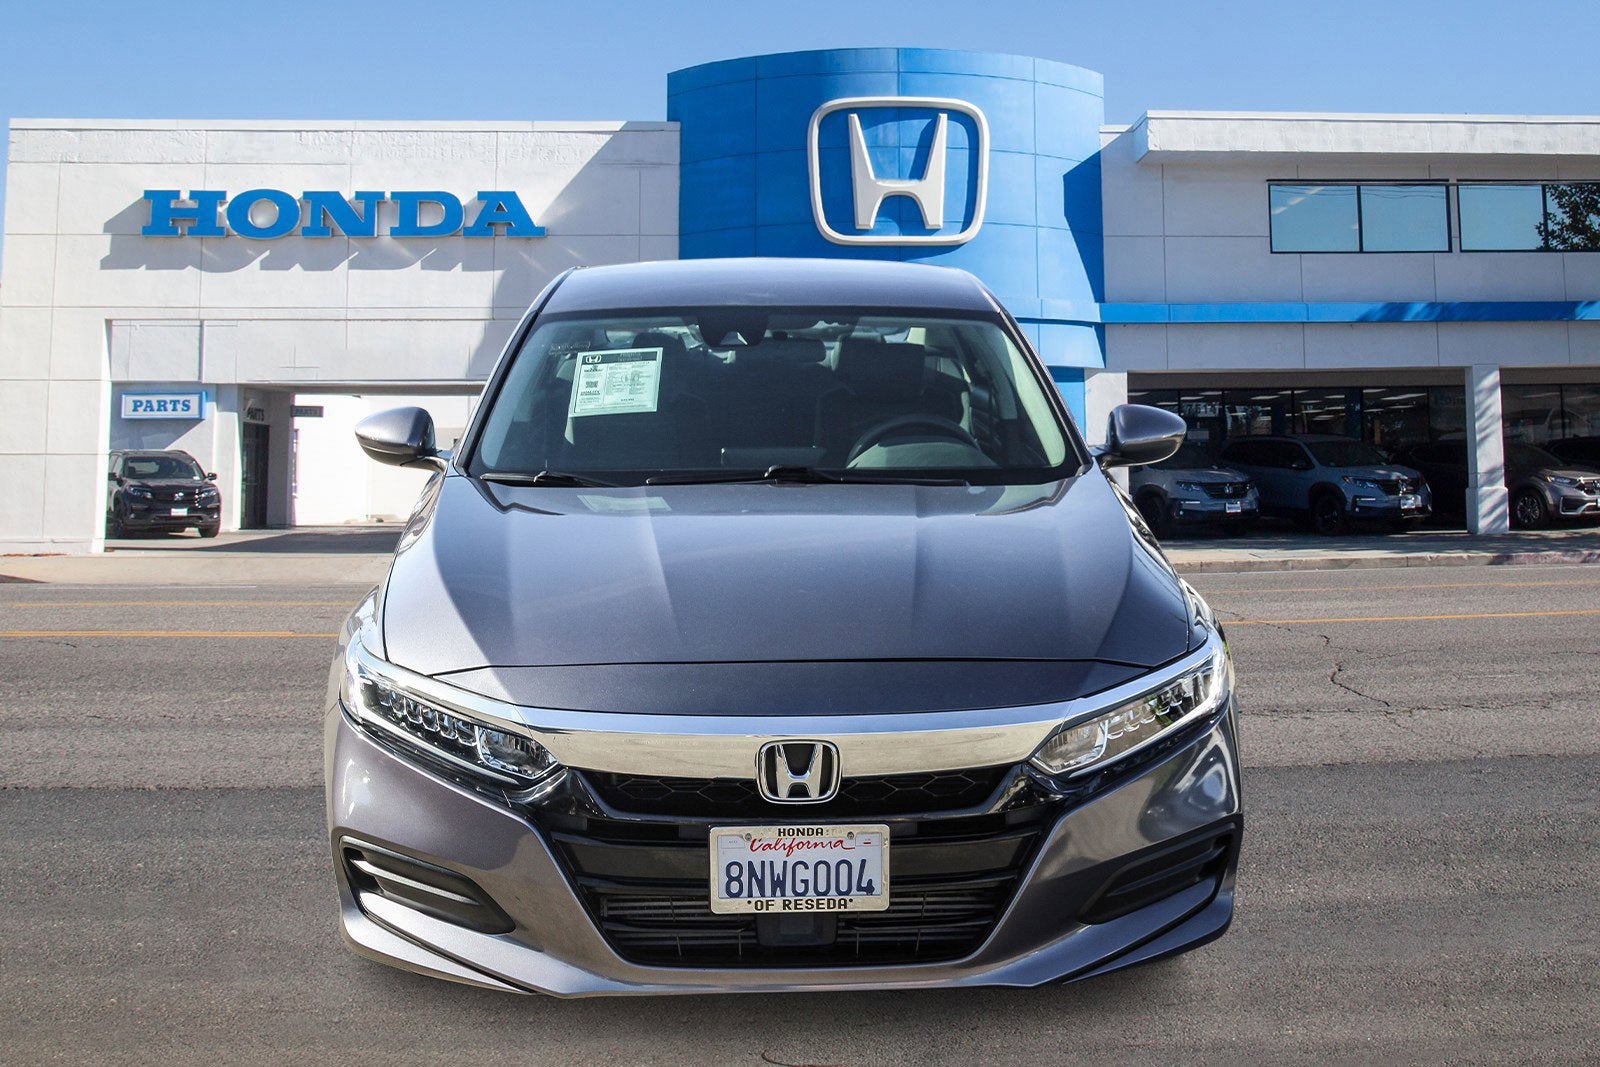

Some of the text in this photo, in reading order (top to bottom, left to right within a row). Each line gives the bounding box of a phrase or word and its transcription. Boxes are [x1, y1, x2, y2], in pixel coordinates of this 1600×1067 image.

[141, 188, 547, 239] HONDA
[132, 399, 191, 412] PARTS
[778, 828, 824, 837] HONDA
[750, 838, 856, 857] California
[725, 859, 875, 898] 8NWG004
[754, 898, 848, 911] OF RESEDA
